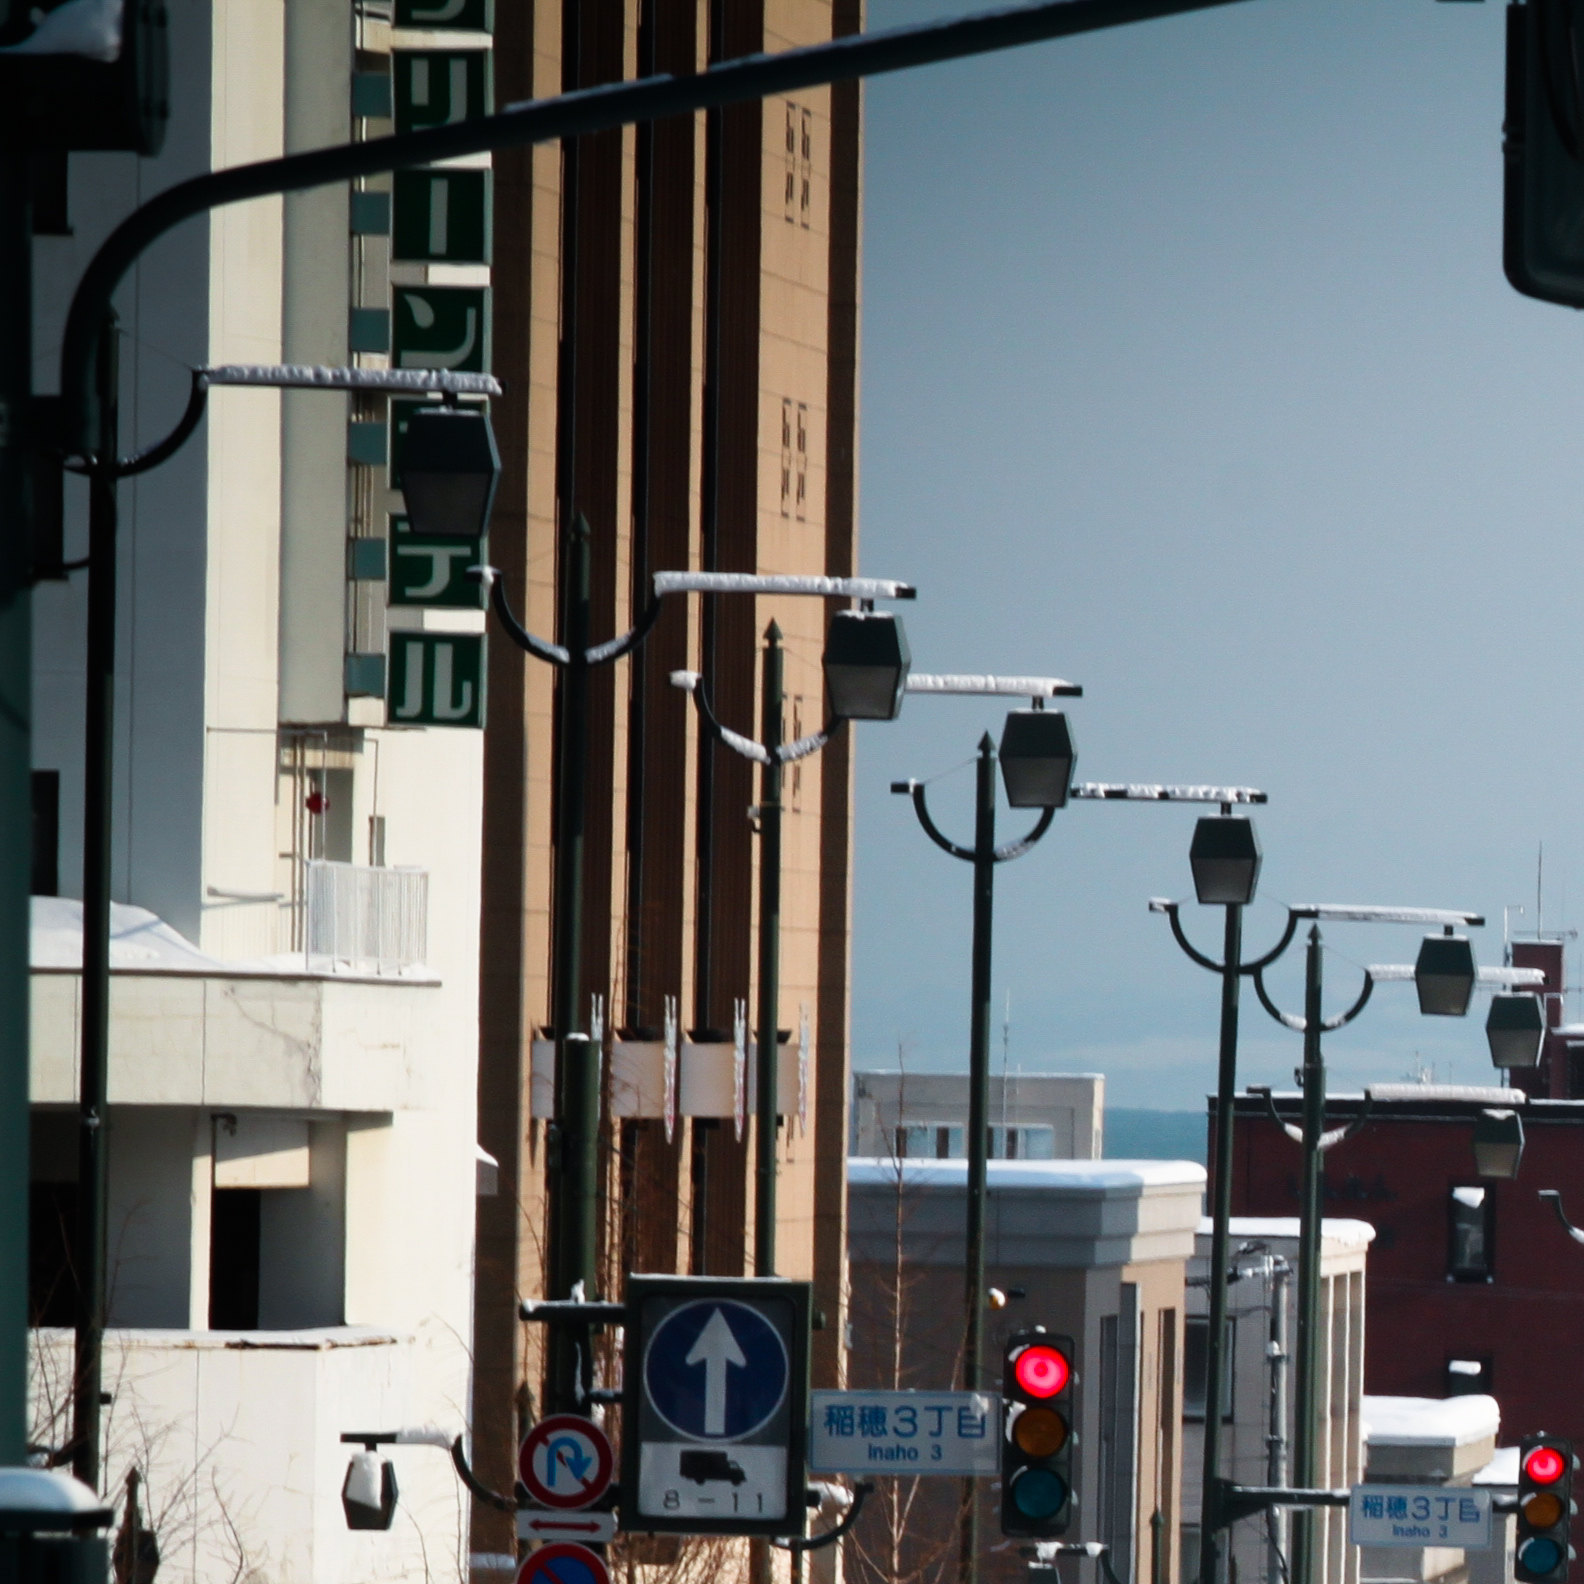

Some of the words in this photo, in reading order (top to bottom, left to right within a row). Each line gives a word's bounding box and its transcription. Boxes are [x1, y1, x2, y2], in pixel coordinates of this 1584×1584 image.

[396, 0, 476, 720] リーンテル
[824, 1405, 986, 1438] 稲穂3丁目
[868, 1443, 918, 1461] Inaho
[931, 1445, 942, 1461] 3
[1363, 1495, 1480, 1523] 稲穂3丁目
[1392, 1525, 1430, 1538] Inaho
[1439, 1525, 1448, 1538] 3
